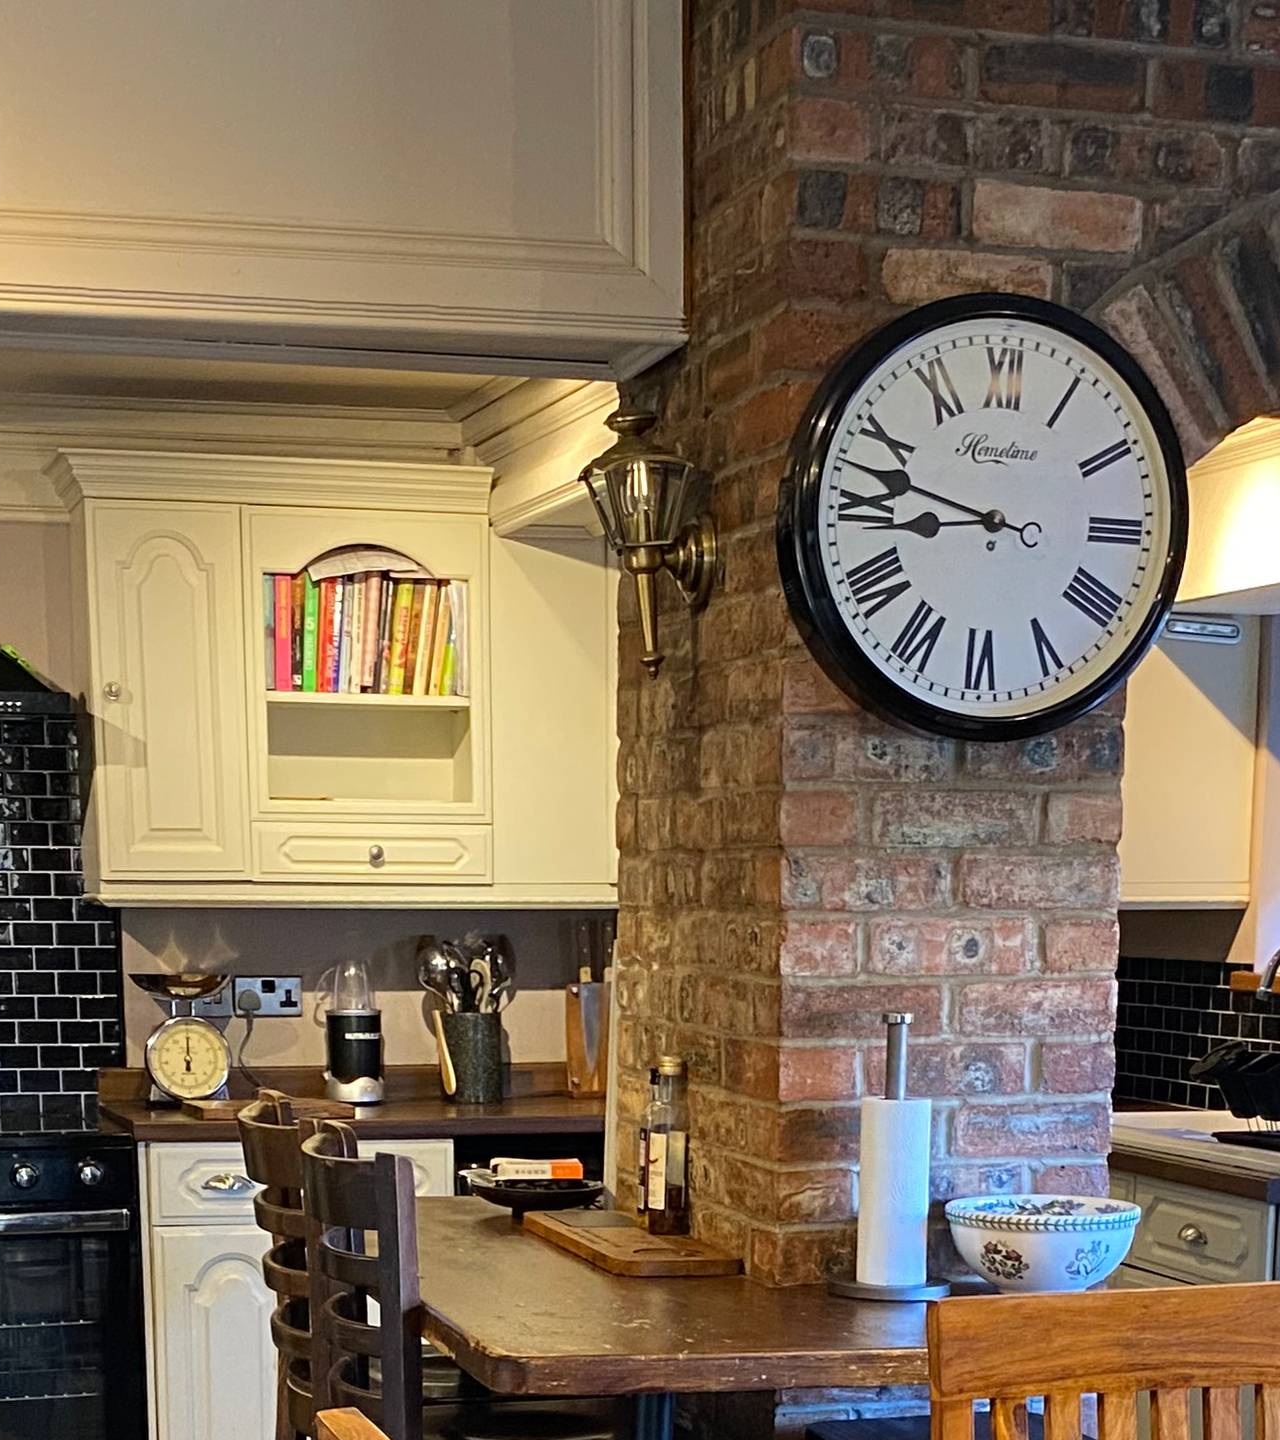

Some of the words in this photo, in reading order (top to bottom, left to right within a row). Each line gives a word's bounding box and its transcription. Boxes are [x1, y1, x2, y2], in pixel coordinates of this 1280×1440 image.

[915, 356, 965, 427] XI
[983, 346, 1024, 412] XII
[859, 415, 916, 467] X
[955, 432, 1038, 467] Hometime
[1078, 438, 1132, 478] II
[1086, 516, 1142, 546] III
[964, 628, 995, 691] VI
